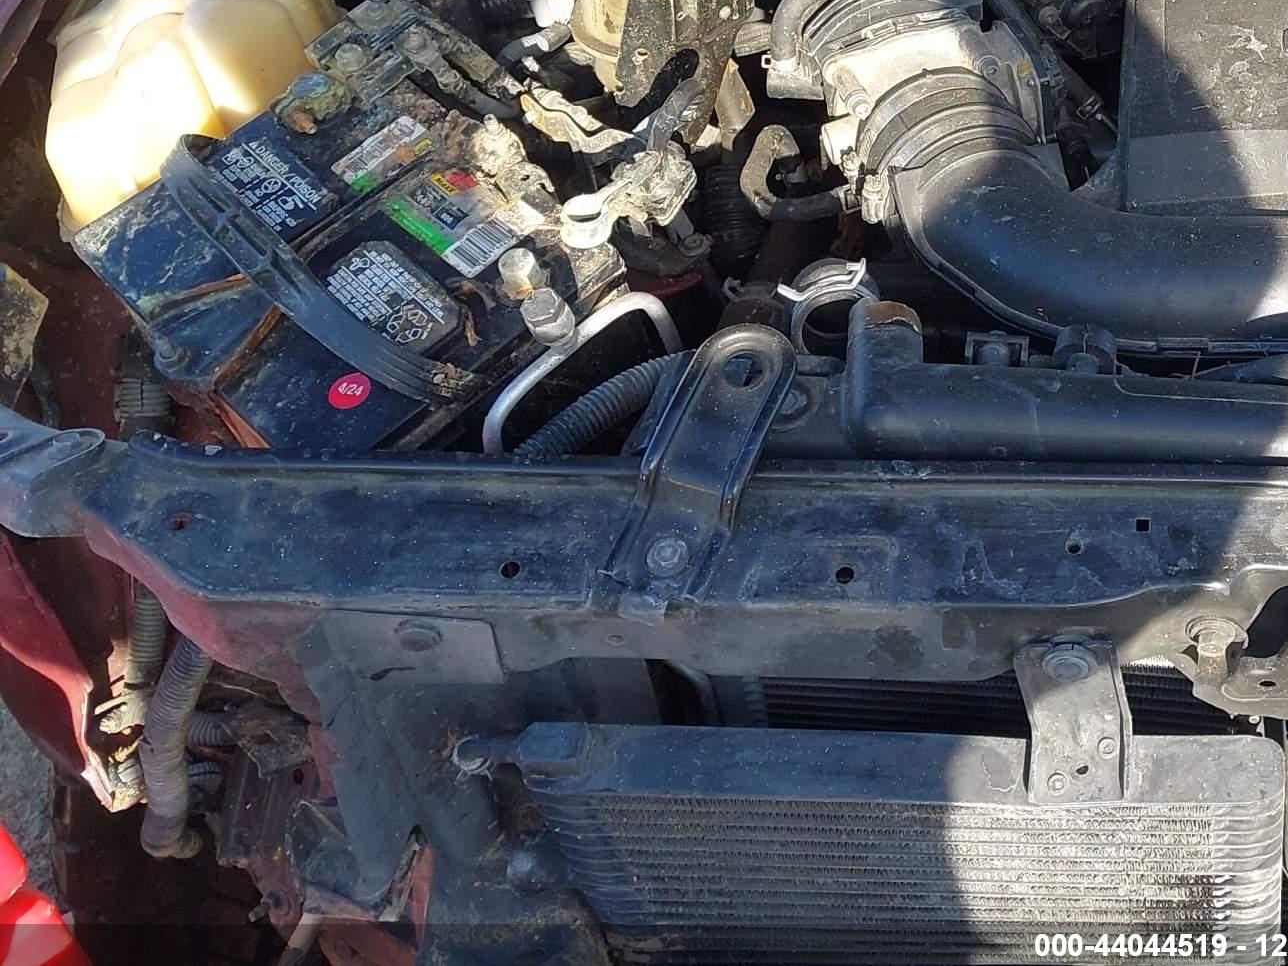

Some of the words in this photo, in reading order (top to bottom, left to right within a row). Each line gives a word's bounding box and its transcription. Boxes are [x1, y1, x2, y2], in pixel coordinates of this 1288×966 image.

[256, 145, 288, 174] DANGER
[289, 176, 321, 204] POISON
[338, 382, 364, 396] 4/24
